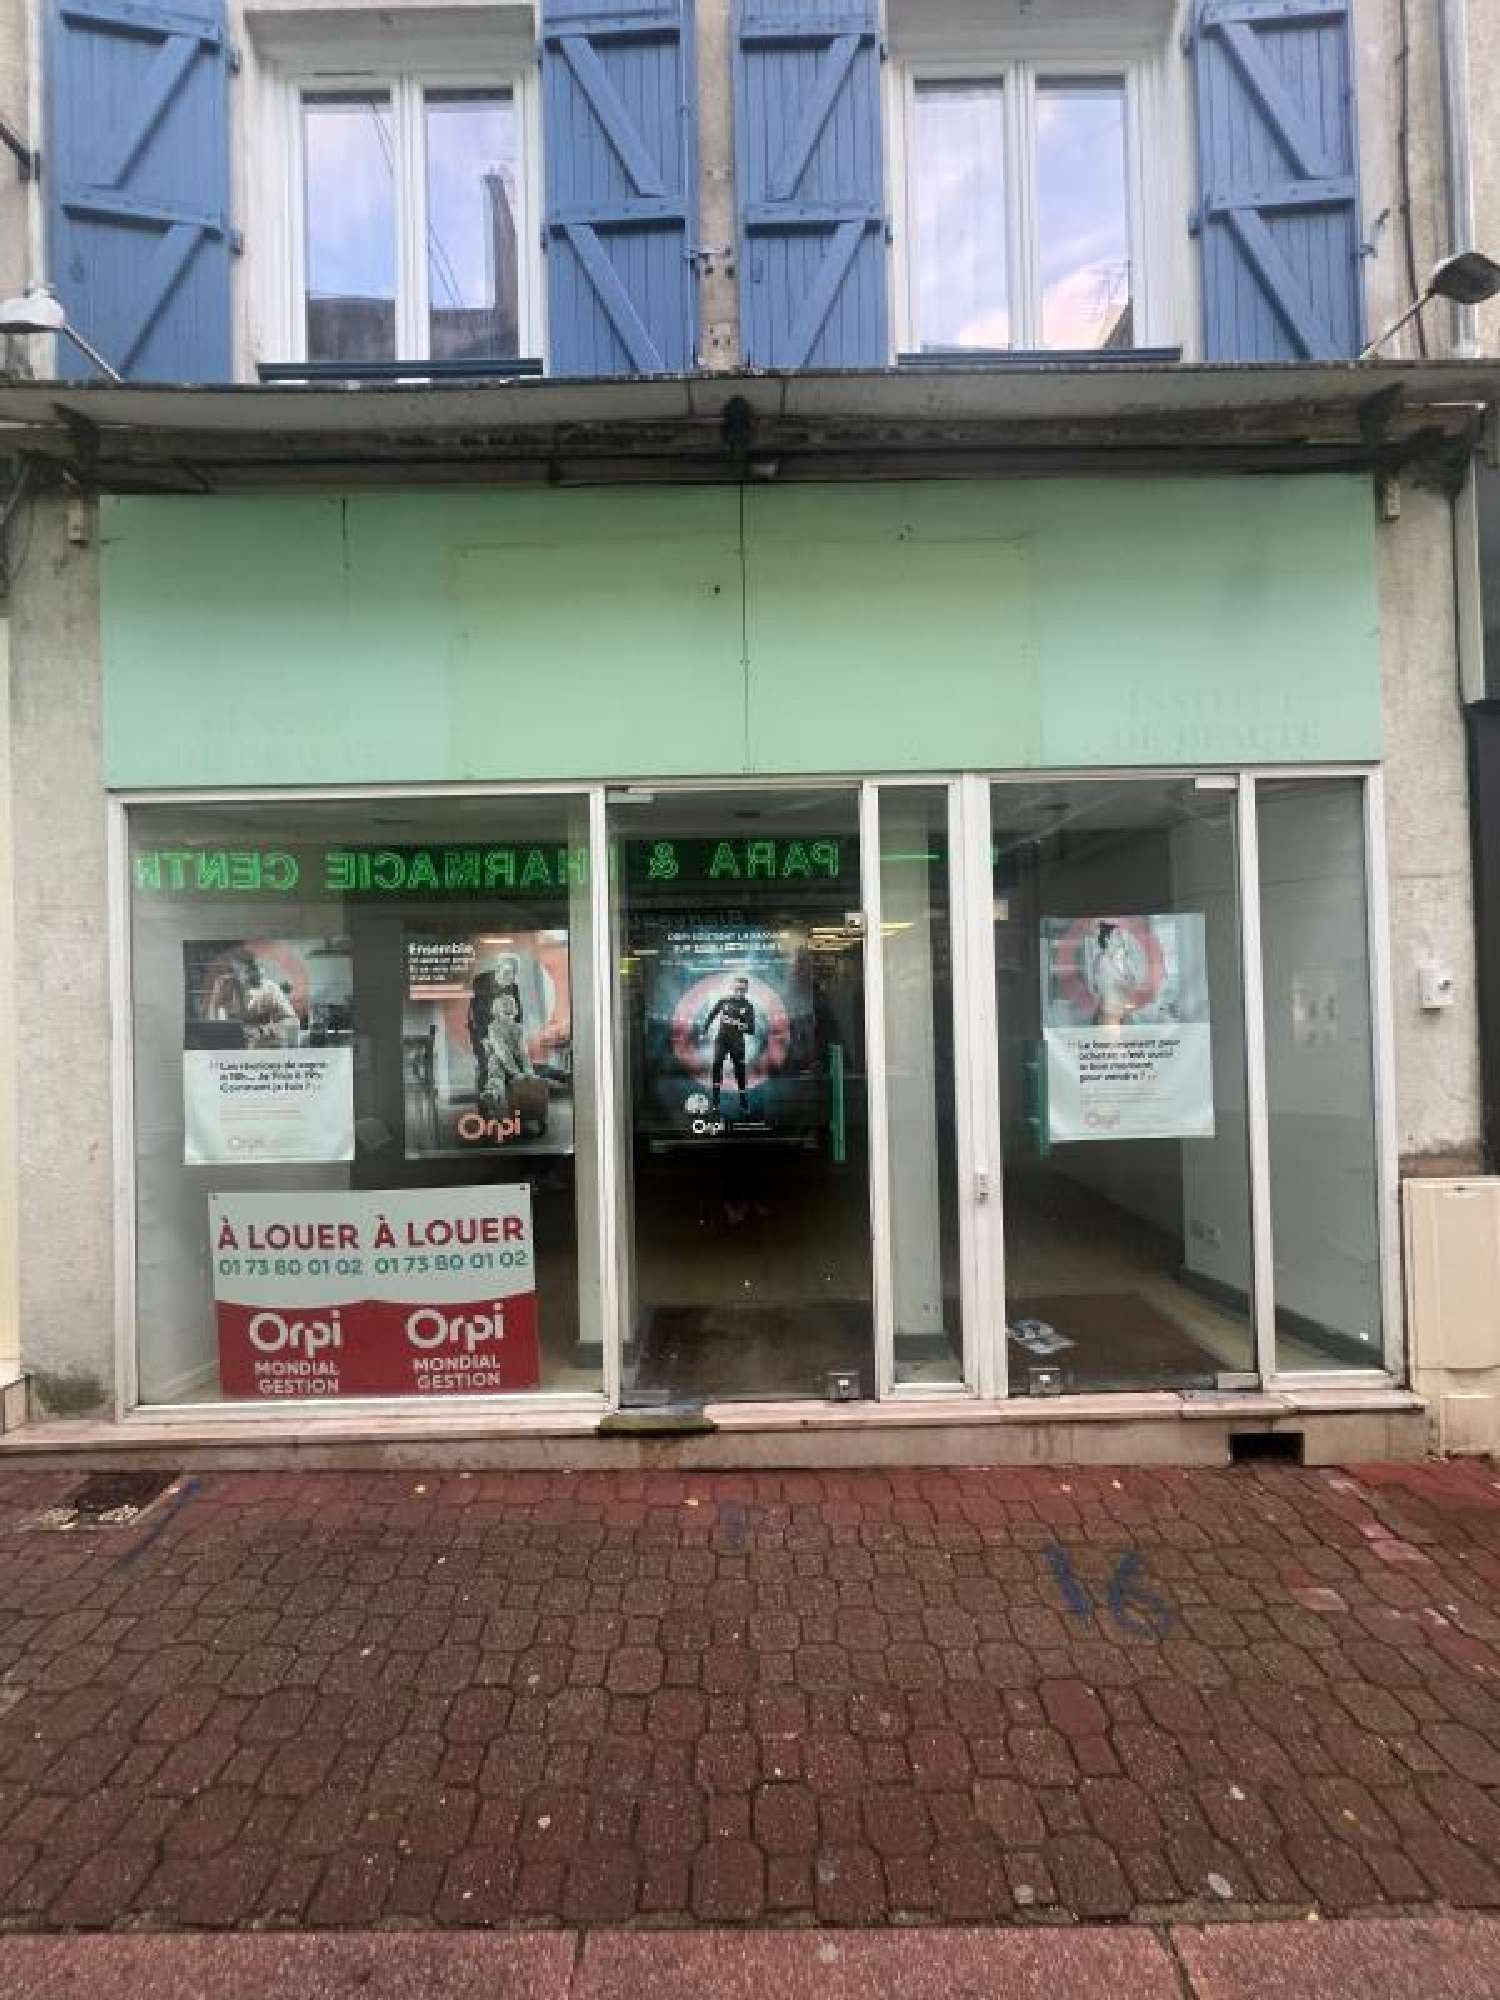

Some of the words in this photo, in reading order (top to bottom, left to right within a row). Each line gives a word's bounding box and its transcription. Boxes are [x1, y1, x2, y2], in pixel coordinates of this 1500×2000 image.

[457, 1109, 521, 1143] Orpi
[218, 1215, 238, 1250] À
[248, 1224, 359, 1250] LOUER
[374, 1214, 396, 1249] À
[407, 1217, 525, 1246] LOUER
[218, 1259, 240, 1276] 01
[245, 1259, 269, 1276] 73
[307, 1259, 329, 1276] 01
[335, 1258, 364, 1276] 02
[374, 1258, 398, 1275] 01
[403, 1256, 429, 1274] 73
[469, 1252, 494, 1270] 01
[499, 1250, 529, 1268] 02
[249, 1309, 342, 1359] Orpi
[406, 1302, 505, 1352] Orpi
[254, 1360, 340, 1377] MONDIAL
[412, 1354, 501, 1374] MONDIAL
[258, 1378, 340, 1395] GESTION
[416, 1372, 500, 1390] GESTION
